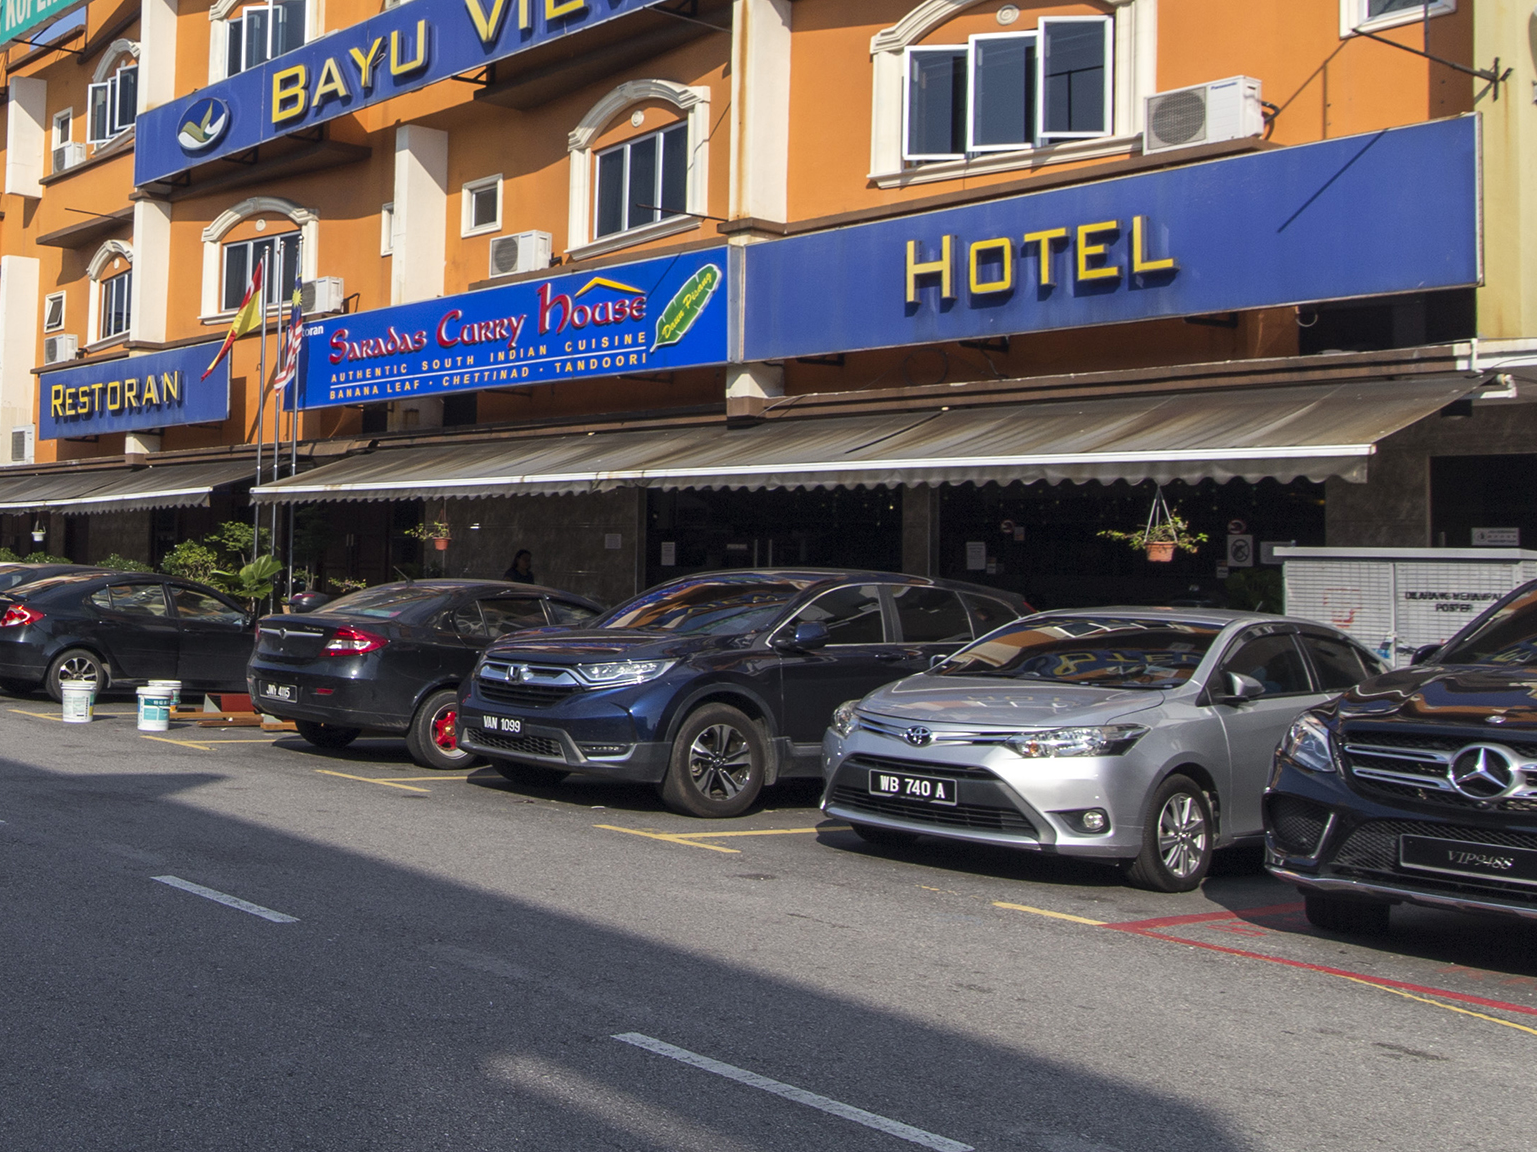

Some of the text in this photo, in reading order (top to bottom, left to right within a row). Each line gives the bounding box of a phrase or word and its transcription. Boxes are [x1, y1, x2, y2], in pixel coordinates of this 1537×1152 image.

[270, 18, 429, 125] BAYU
[906, 215, 1177, 303] HOTEL
[436, 309, 527, 348] Curry
[330, 353, 647, 400] BANANA LEAF CHETTINAD TANDOORI
[331, 332, 647, 383] AUTHENTIC SOUTH INDIAN CUISINE
[51, 370, 181, 418] RESTORAN
[483, 715, 521, 733] VAN 1099
[880, 774, 946, 799] WB 740 A
